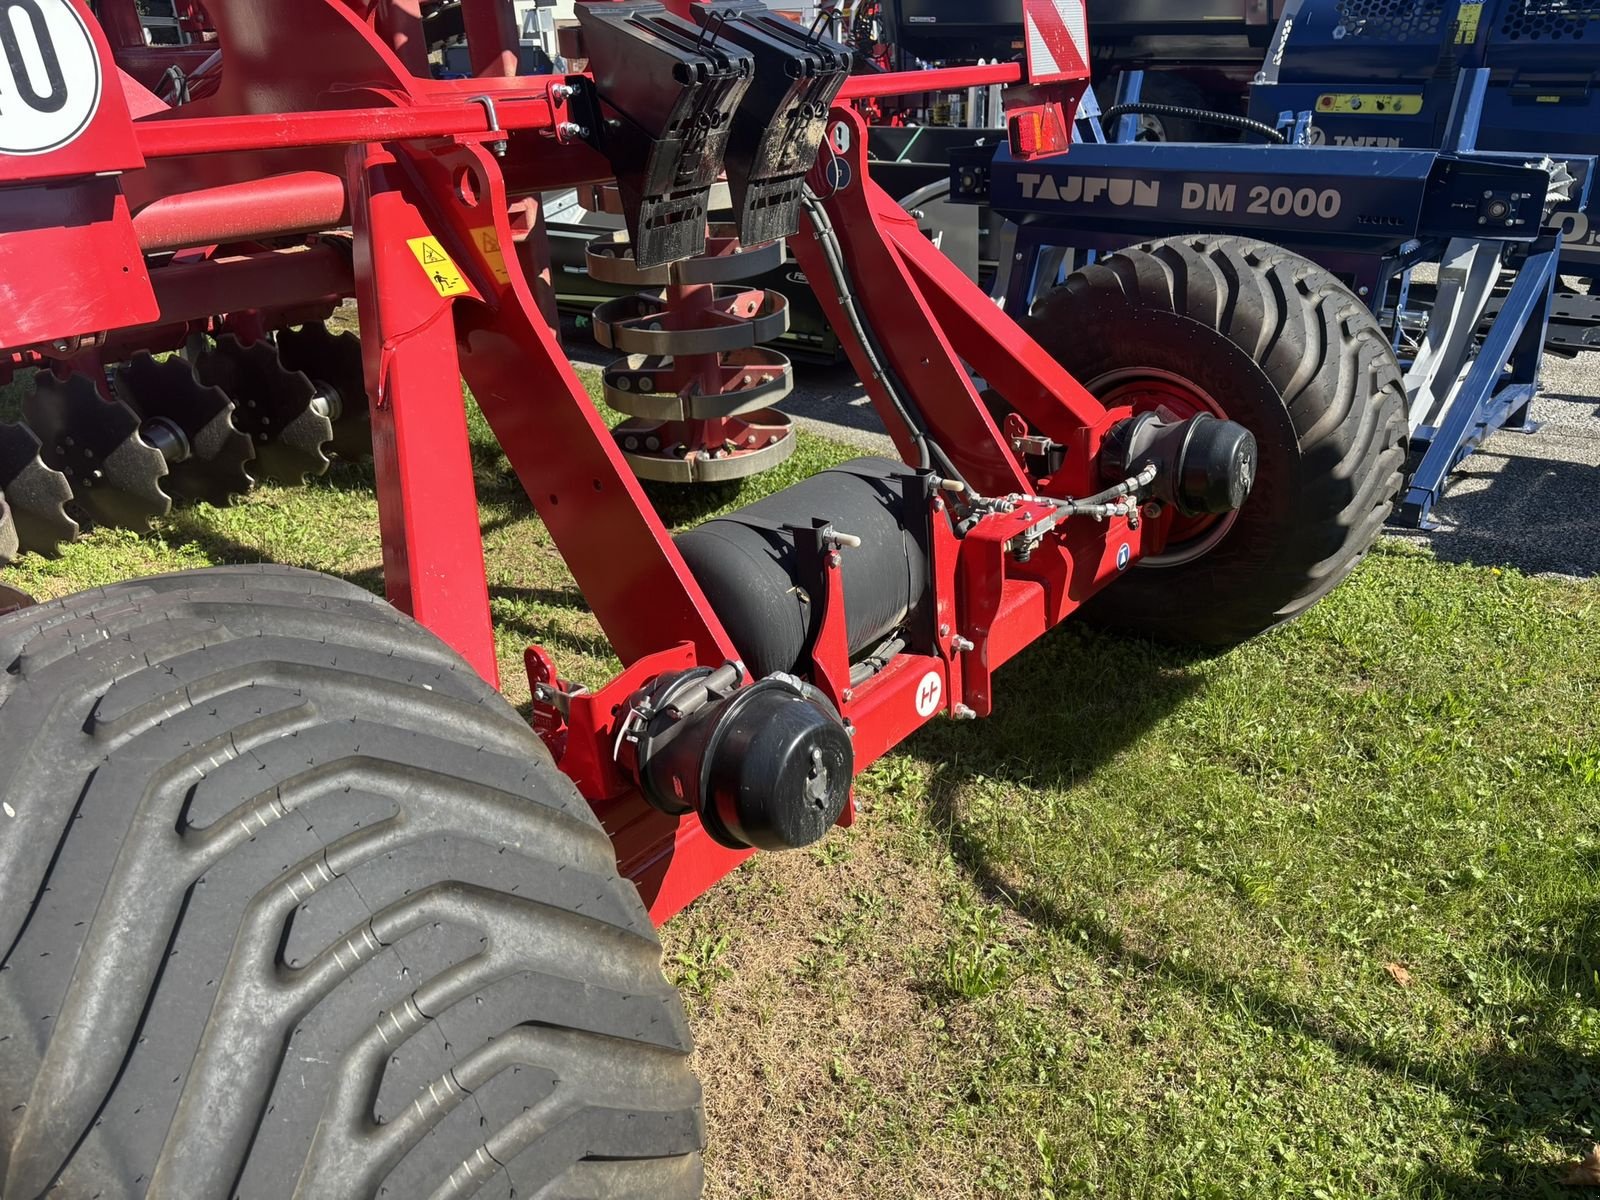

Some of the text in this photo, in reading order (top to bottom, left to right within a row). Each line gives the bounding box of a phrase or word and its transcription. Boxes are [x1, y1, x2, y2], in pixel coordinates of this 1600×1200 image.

[0, 0, 68, 114] 0
[1333, 136, 1401, 148] TAJFUN
[1016, 173, 1341, 218] TAJFUN DM 2000
